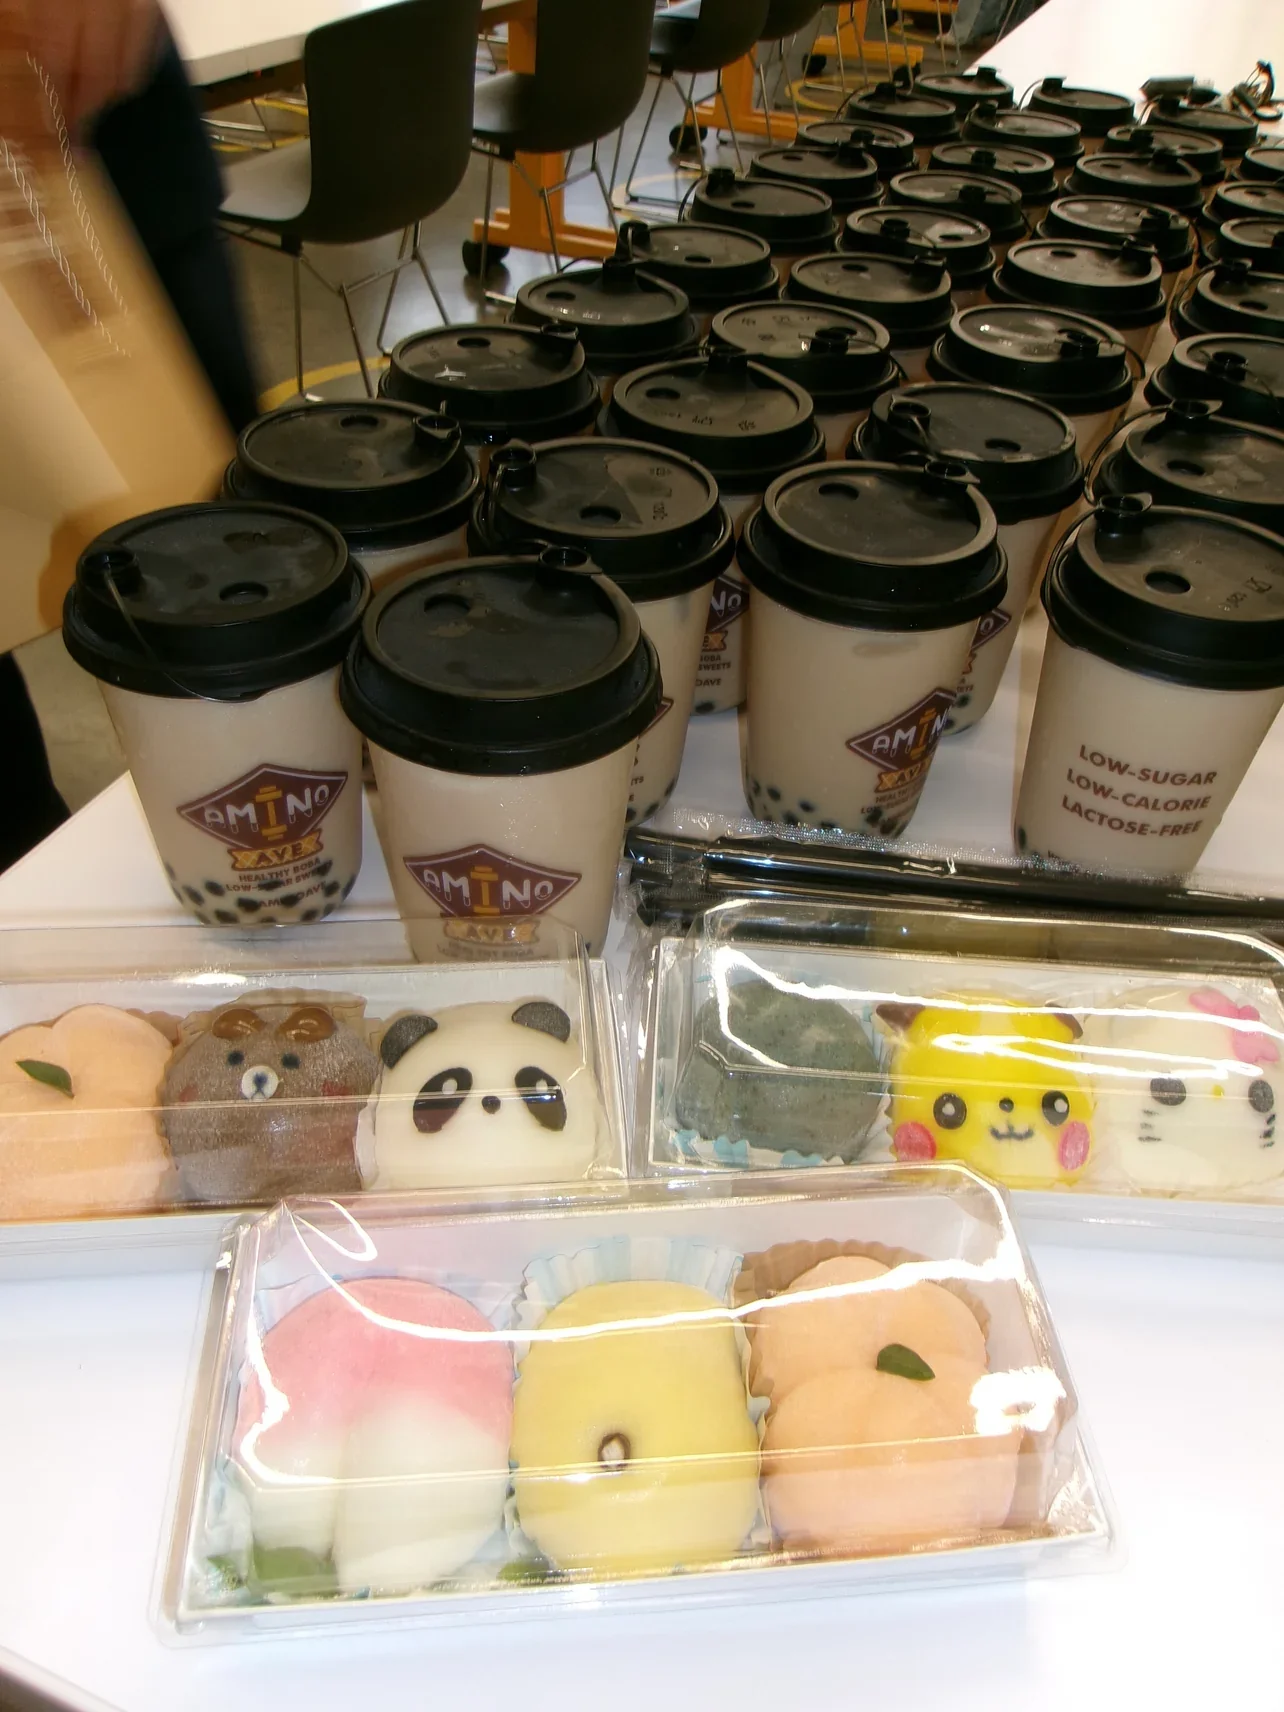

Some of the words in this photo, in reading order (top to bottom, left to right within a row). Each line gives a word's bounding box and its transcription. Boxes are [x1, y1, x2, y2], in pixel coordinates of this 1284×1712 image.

[872, 706, 953, 759] AMIN
[1079, 744, 1217, 787] LOW-SUGAR
[1067, 767, 1212, 812] LOW-CALORIE
[204, 784, 330, 841] AMINO
[1061, 794, 1203, 837] LACTOSE-FREE
[239, 868, 290, 883] HEALTHY
[293, 858, 321, 873] BOBA
[255, 842, 303, 866] AVE
[423, 866, 554, 915] AMINO
